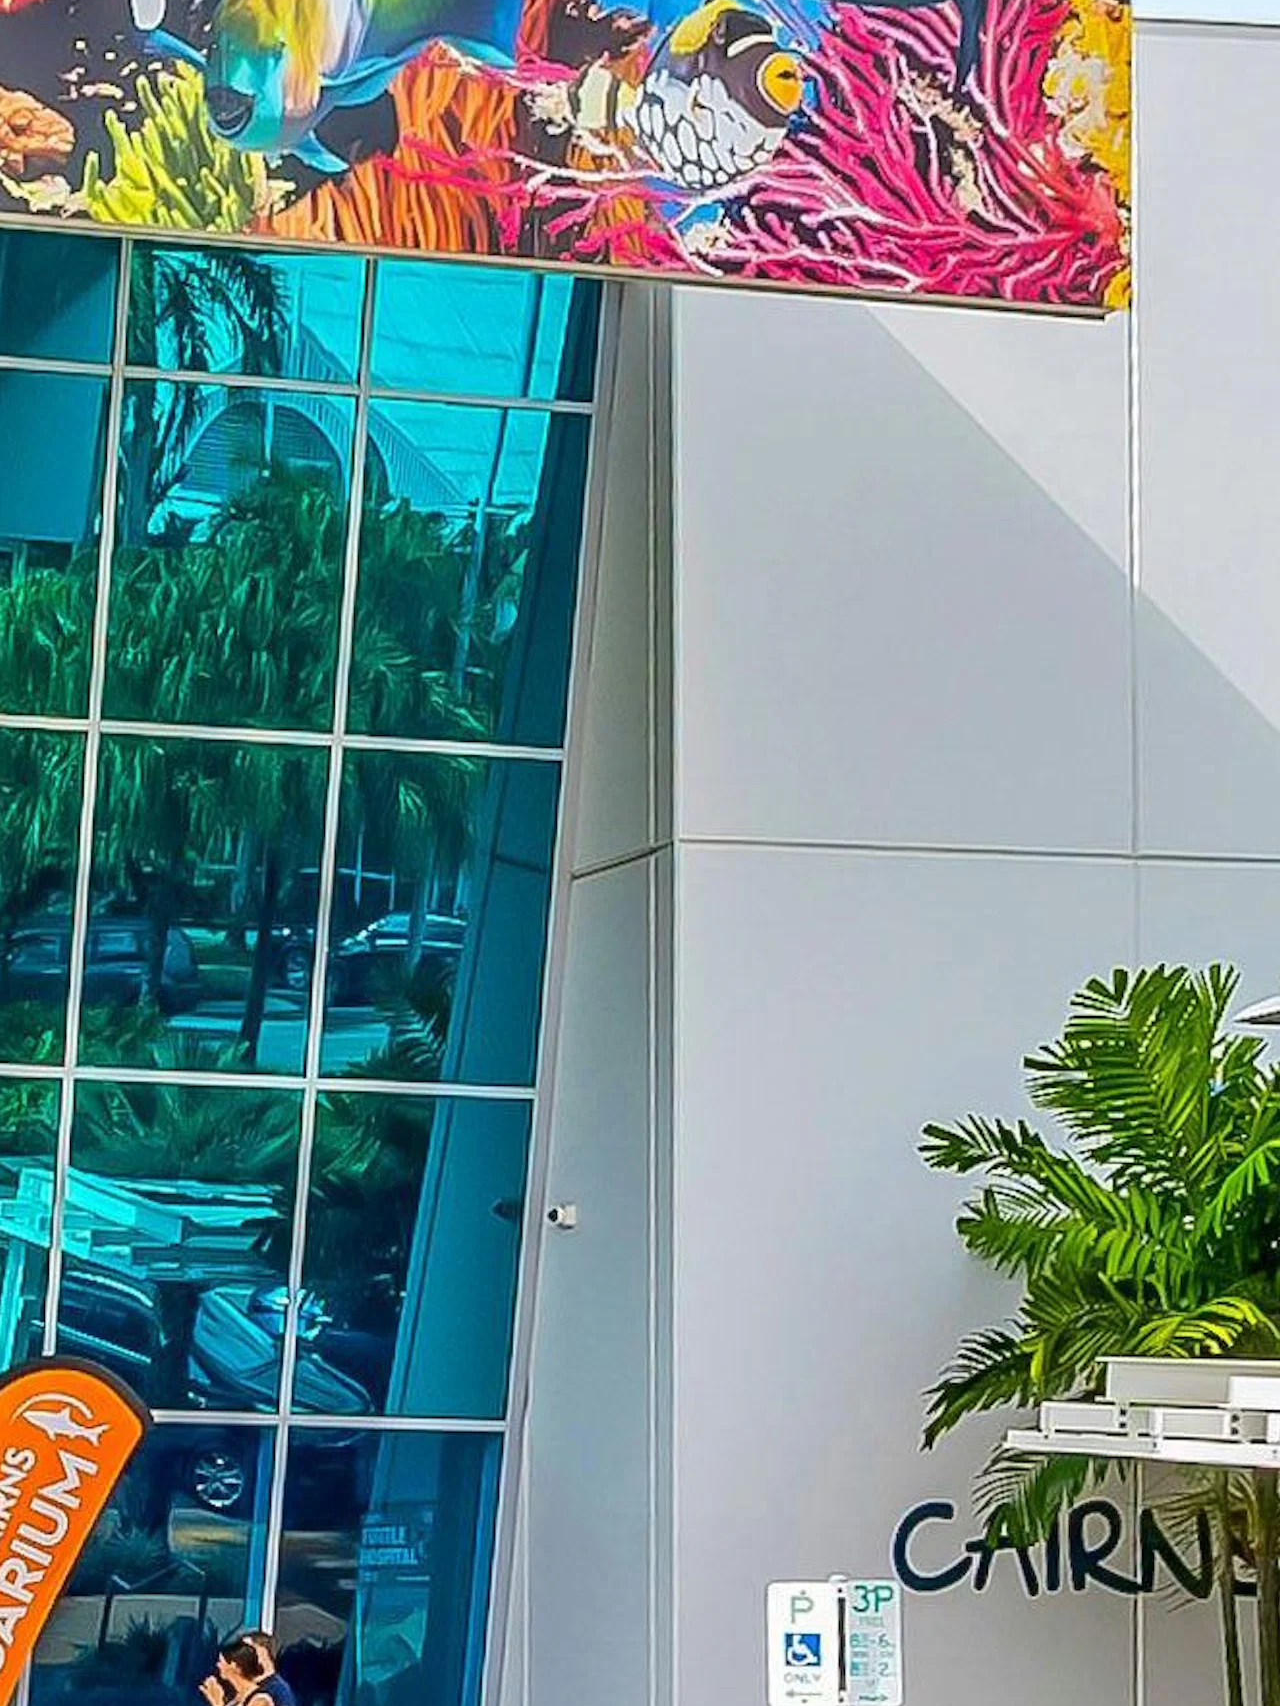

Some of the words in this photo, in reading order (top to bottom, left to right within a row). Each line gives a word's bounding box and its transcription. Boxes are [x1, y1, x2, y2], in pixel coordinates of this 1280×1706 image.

[791, 1596, 814, 1624] P
[852, 1585, 894, 1613] 3P
[783, 1672, 822, 1685] ONLY
